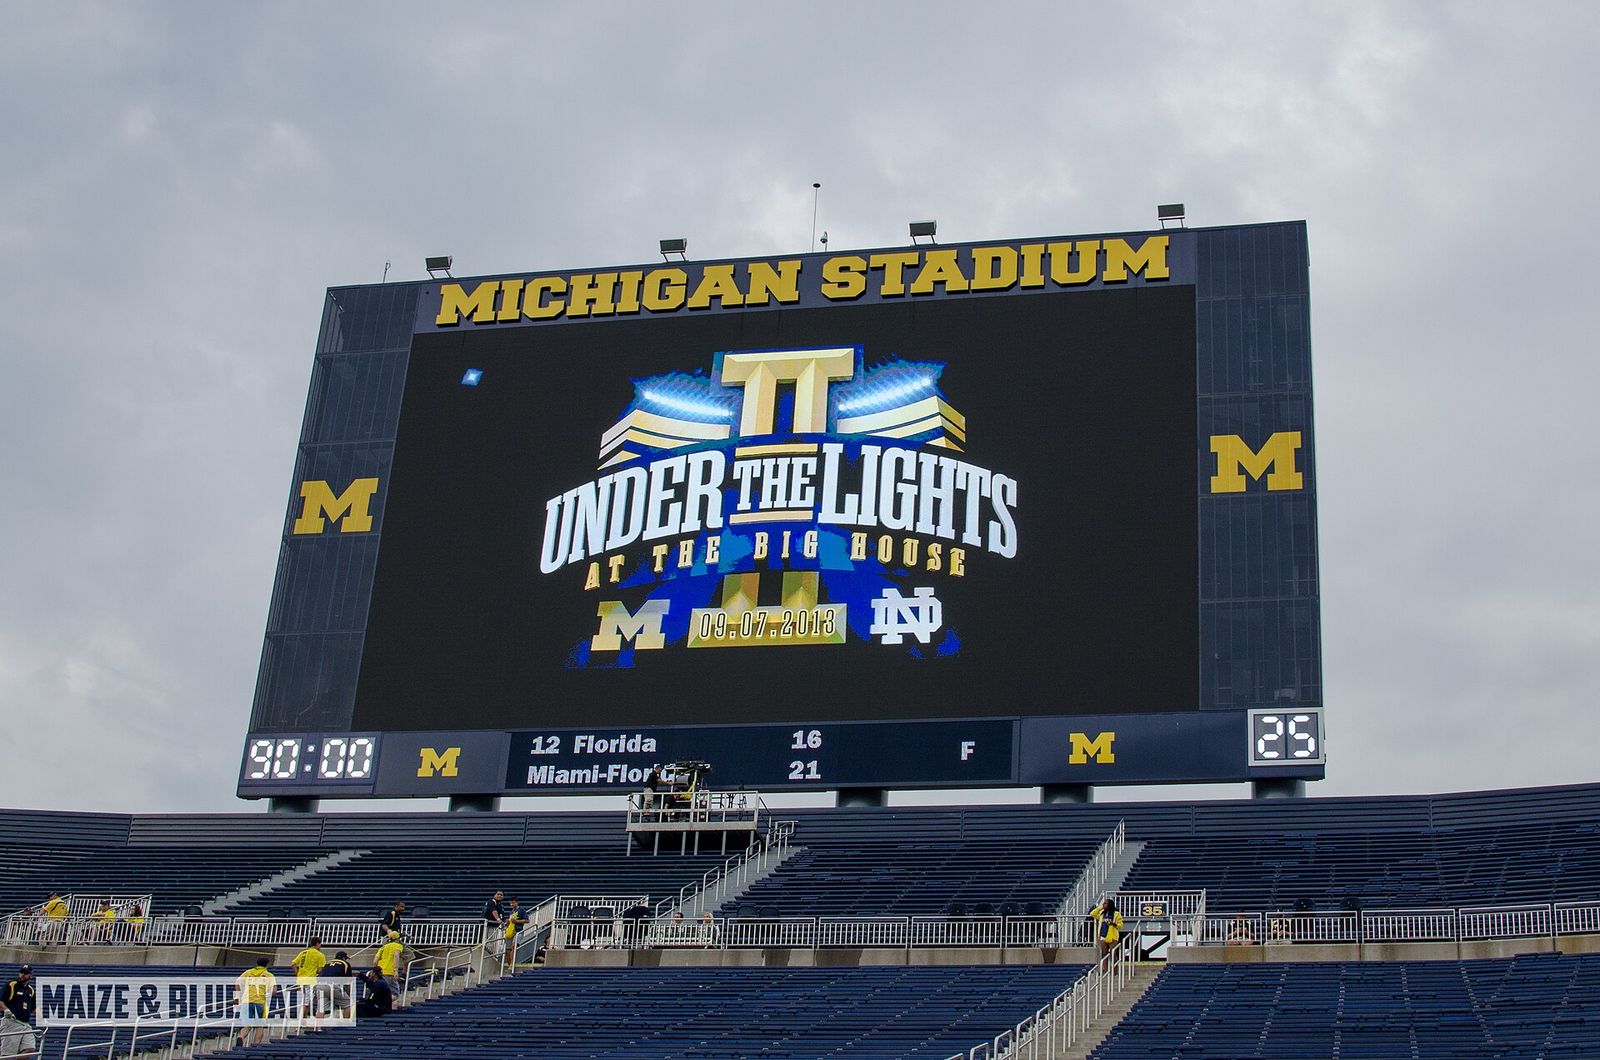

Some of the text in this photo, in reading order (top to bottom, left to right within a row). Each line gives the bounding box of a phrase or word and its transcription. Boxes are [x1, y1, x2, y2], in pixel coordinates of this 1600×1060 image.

[436, 236, 1170, 326] MICHIGAN STADIUM
[1209, 431, 1303, 494] M
[293, 477, 379, 535] M
[540, 443, 1019, 575] UNDER THE LIGHTS
[584, 531, 966, 591] AT THE BIG HOUSE
[699, 608, 837, 640] 09.07.2013
[530, 730, 822, 755] 12 Florida 16
[960, 740, 976, 760] F
[1068, 731, 1116, 764] M
[1257, 714, 1316, 759] 25
[251, 738, 373, 780] 90:00
[417, 747, 462, 778] M
[789, 760, 822, 781] 21
[1142, 906, 1163, 916] 35
